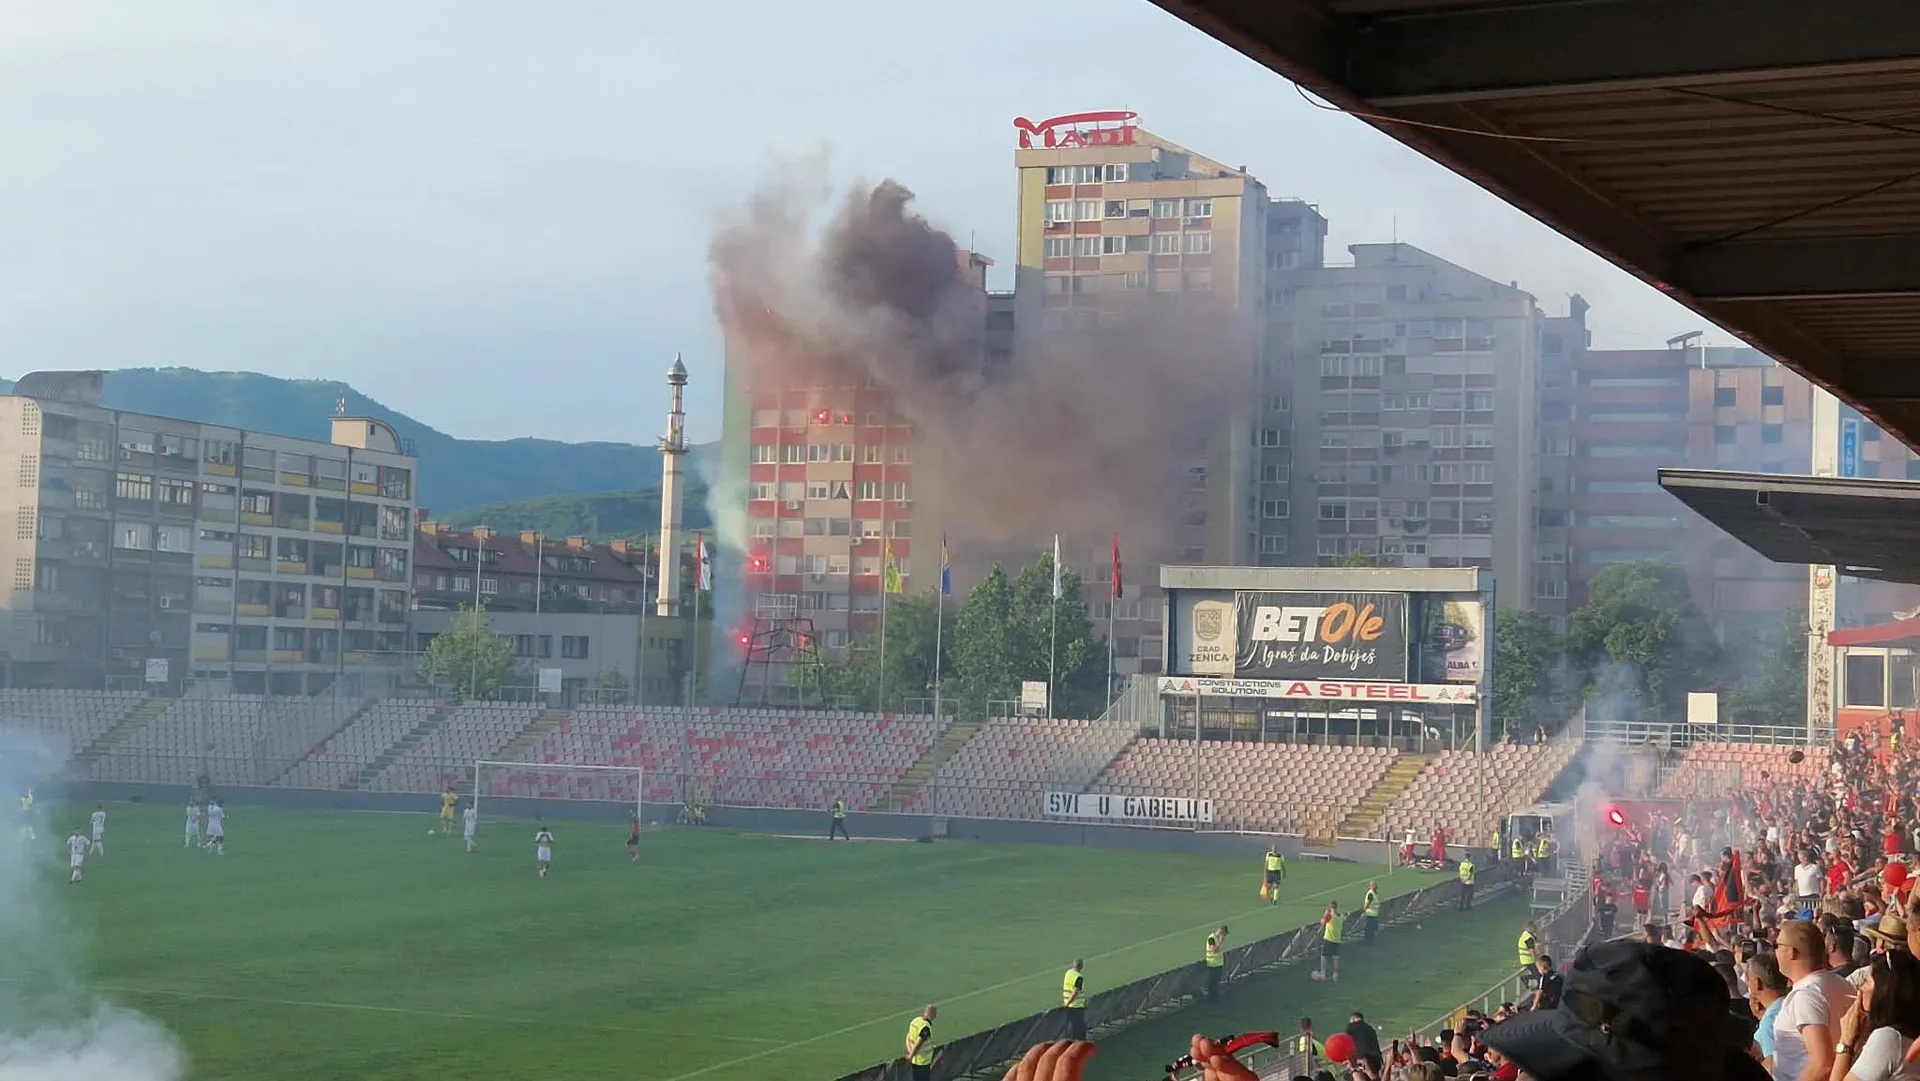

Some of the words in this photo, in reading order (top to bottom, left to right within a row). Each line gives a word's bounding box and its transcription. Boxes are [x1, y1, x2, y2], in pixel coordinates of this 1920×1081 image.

[1187, 653, 1229, 662] ZENICA
[1262, 645, 1296, 668] Igraš
[1300, 647, 1319, 661] da
[1323, 645, 1377, 670] Dobiješ
[1447, 660, 1470, 669] ALBA
[1197, 679, 1281, 689] CONSTRUCTIONS
[1211, 687, 1268, 695] SOLUTIONS
[1285, 682, 1312, 697] A
[1319, 683, 1430, 700] STEEL
[1049, 793, 1078, 814] SVI
[1098, 795, 1110, 816] U
[1123, 797, 1210, 821] GABELU!
